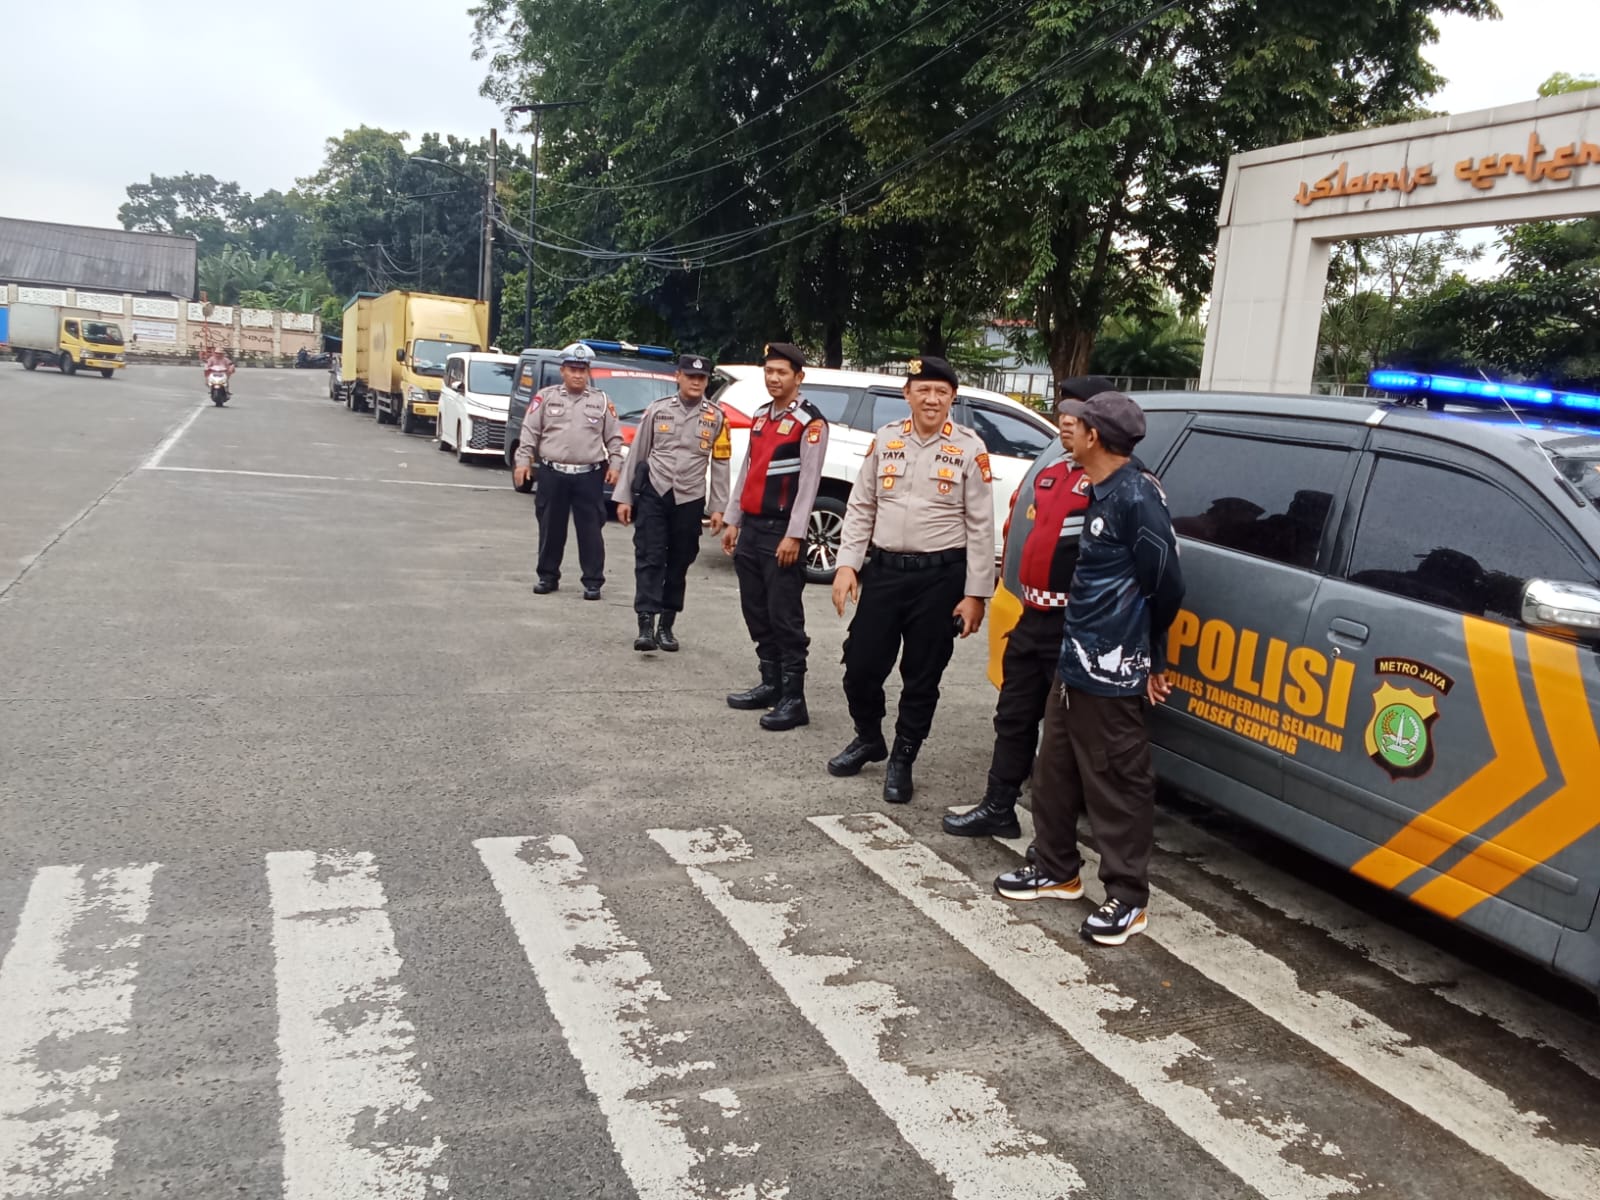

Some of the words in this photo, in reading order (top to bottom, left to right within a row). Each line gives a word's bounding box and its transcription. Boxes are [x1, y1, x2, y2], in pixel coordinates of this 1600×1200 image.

[882, 451, 905, 460] YAYA
[935, 454, 964, 468] POLRI
[1166, 608, 1355, 729] POLISI
[1380, 661, 1419, 675] METRO
[1420, 669, 1446, 690] JAYA
[1187, 697, 1235, 729] POLSEK
[1234, 716, 1298, 756] SERPONG
[1206, 684, 1280, 728] TANGERANG
[1281, 713, 1343, 753] SELATAN
